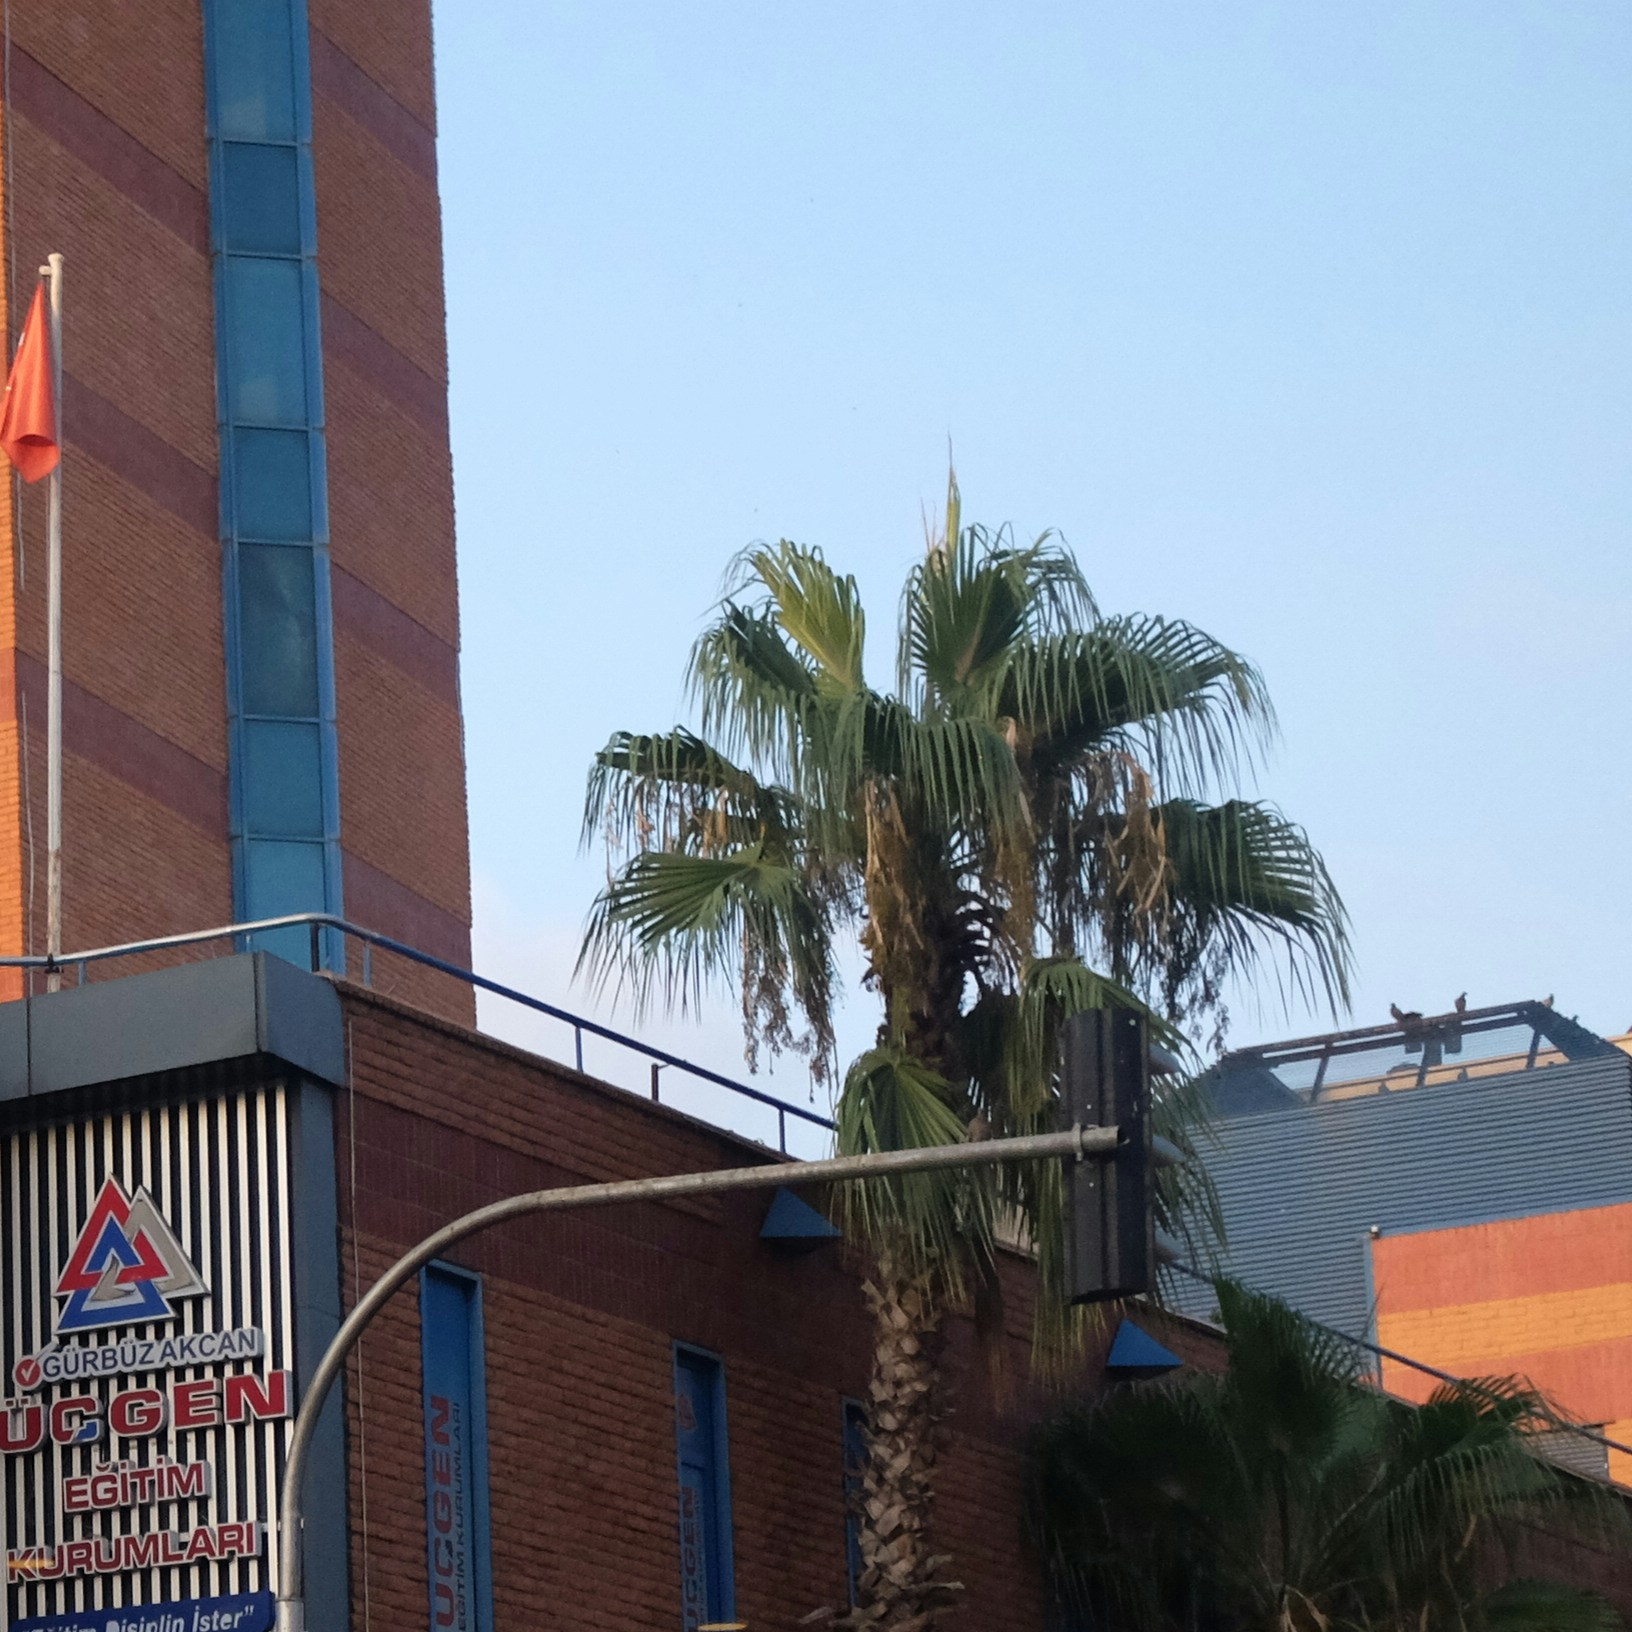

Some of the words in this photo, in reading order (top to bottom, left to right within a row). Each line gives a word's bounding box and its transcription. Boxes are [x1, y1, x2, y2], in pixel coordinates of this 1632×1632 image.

[42, 1339, 154, 1379] GÜRBÜZ
[158, 1327, 257, 1366] AKCAN
[64, 1455, 210, 1513] EĞİTİM
[7, 1520, 260, 1584] KURUMLARI
